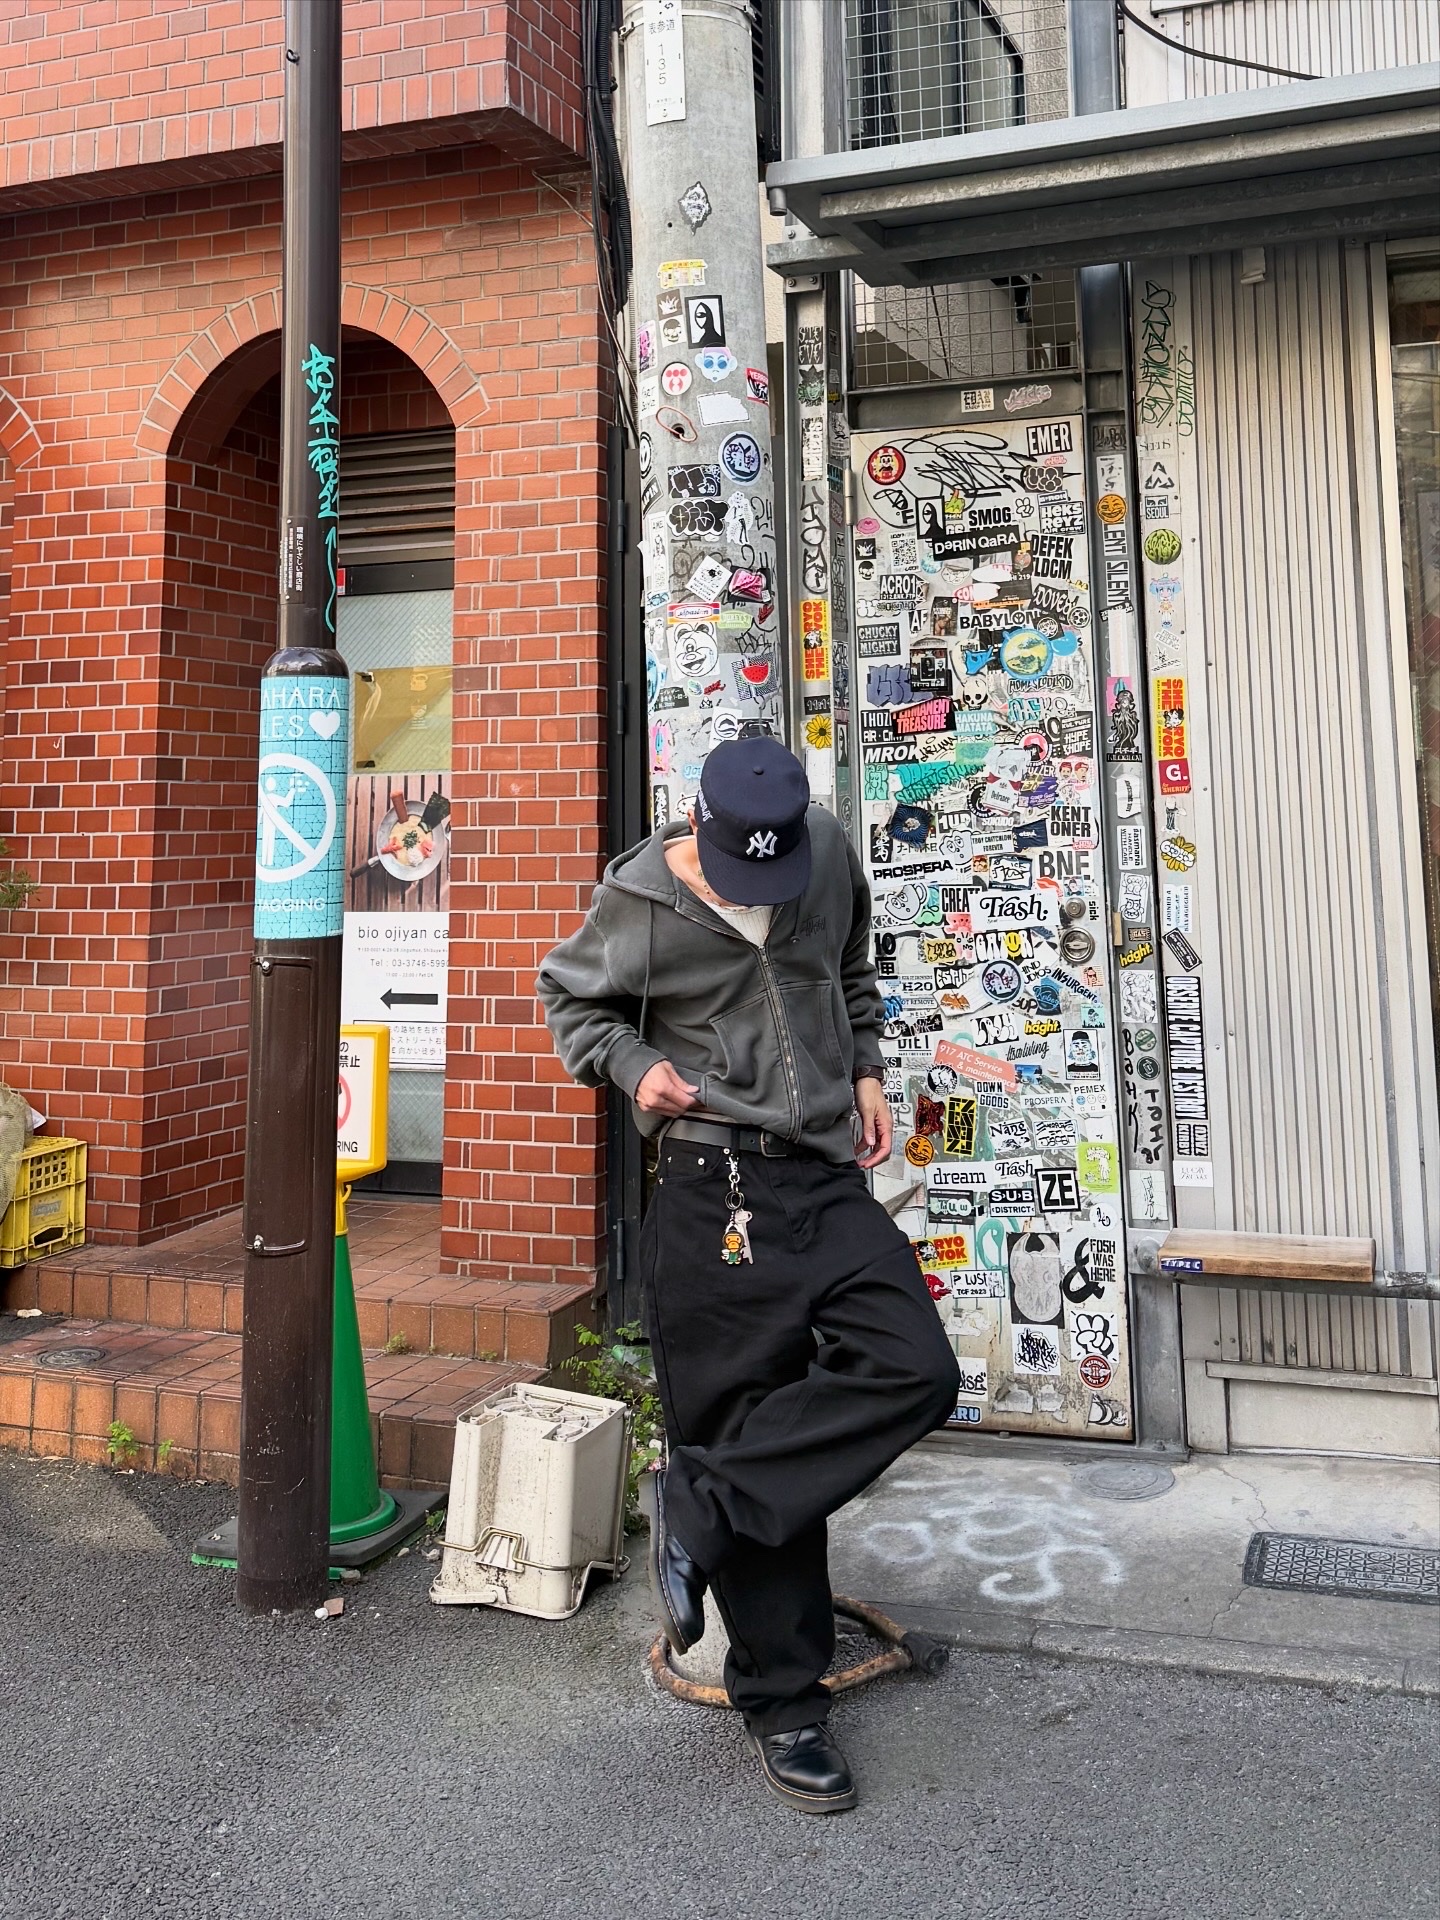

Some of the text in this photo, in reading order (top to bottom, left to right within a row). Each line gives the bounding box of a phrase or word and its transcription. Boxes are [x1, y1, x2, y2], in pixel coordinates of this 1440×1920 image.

[1028, 423, 1072, 455] EMER
[969, 507, 1011, 526] SMOG
[1146, 507, 1168, 519] SEOUL
[1032, 535, 1074, 559] DEFEK
[858, 625, 898, 640] CHUCKY
[859, 640, 898, 654] MIGHTY
[893, 699, 950, 720] ERMANENT
[955, 712, 994, 723] HAKUNA
[897, 713, 947, 734] TREASURE
[955, 723, 993, 733] MATATA
[1064, 730, 1089, 744] HYPE
[1165, 764, 1188, 781] G.
[1050, 806, 1091, 822] KENT
[1050, 822, 1091, 838] ONER
[745, 830, 779, 858] NY
[873, 861, 954, 881] PROSPERA
[980, 895, 1049, 922] Trash.
[1088, 900, 1101, 922] sick
[358, 926, 379, 939] bio
[385, 926, 427, 942] ojiyan
[370, 958, 383, 967] Tel
[1166, 976, 1203, 1018] OBSERVE
[1168, 1020, 1205, 1075] CAPTURE
[939, 1044, 1004, 1074] 917 ATC Service
[956, 1061, 966, 1069] &
[976, 1081, 1002, 1093] DOWN
[1073, 1084, 1106, 1095] PEMEX
[979, 1094, 1009, 1109] GOODS
[1171, 1077, 1208, 1120] DESTROY
[933, 1168, 987, 1185] dream
[994, 1159, 1035, 1179] Trash
[1042, 1172, 1076, 1206] ZE
[1090, 1238, 1116, 1253] FOSH
[1093, 1253, 1115, 1266] WAS
[1091, 1266, 1116, 1282] HERE
